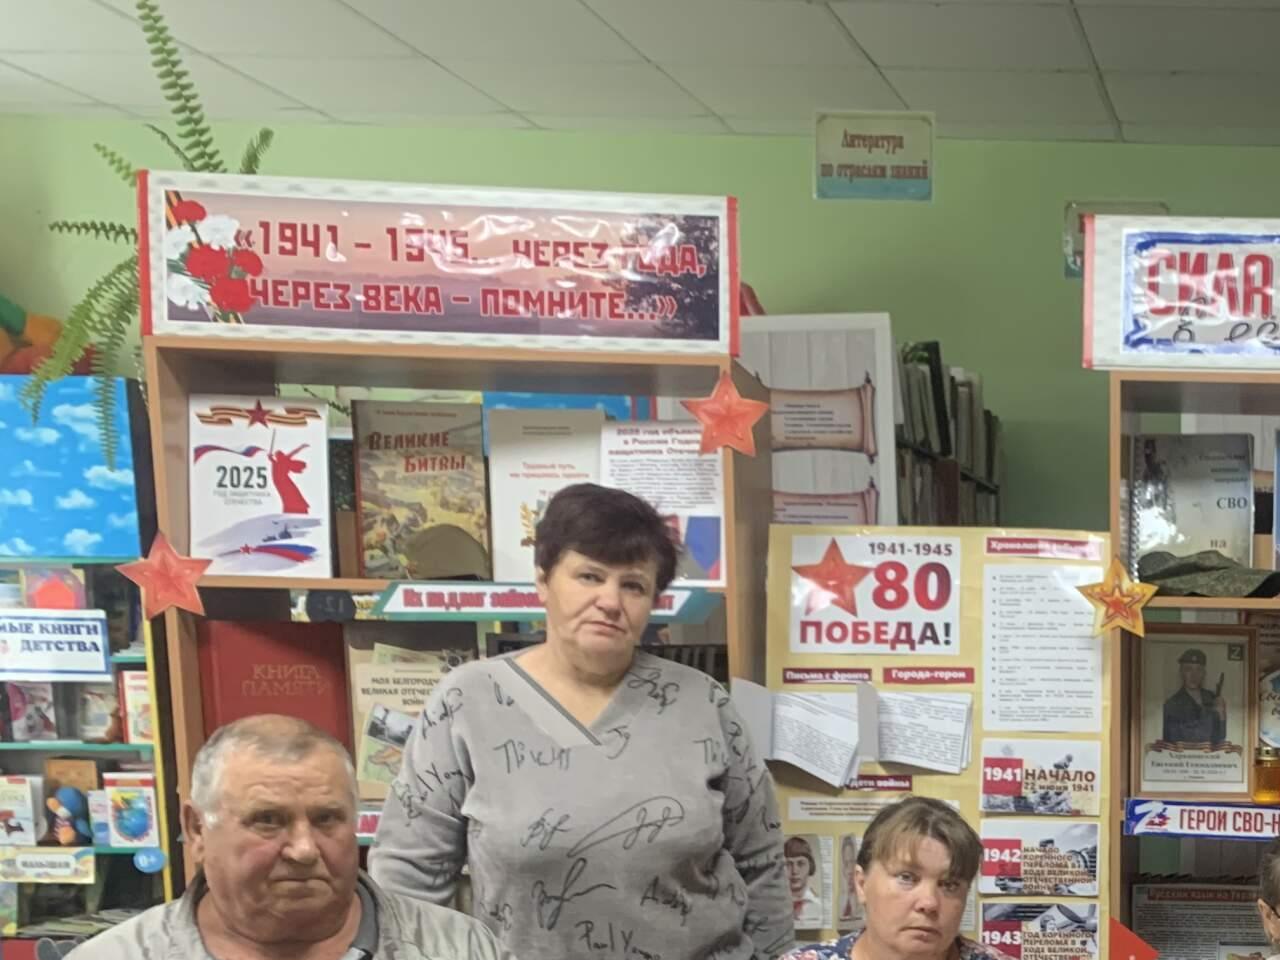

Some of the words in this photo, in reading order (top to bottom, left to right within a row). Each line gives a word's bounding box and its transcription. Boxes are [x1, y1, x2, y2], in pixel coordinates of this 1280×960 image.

[841, 128, 904, 154] Литература
[512, 239, 609, 269] ЧЕРЕЗ
[249, 278, 351, 311] ЧЕРЕЗ
[361, 283, 444, 317] ВЕКА
[215, 465, 268, 489] 2025
[1216, 496, 1248, 509] СВО
[868, 542, 954, 558] 1941-1945
[871, 560, 953, 611] 80
[39, 623, 99, 636] КНИГИ
[799, 619, 952, 651] ПОБЕДА!
[20, 639, 101, 653] ДЕТСТВА
[252, 664, 321, 681] КНИГА
[785, 670, 824, 680] Письма
[891, 669, 967, 682] Города-герои
[240, 680, 333, 698] ПАМЯТИ
[392, 677, 439, 686] БЕЛГОРОДЧ
[361, 687, 399, 696] ВЕЛИКАЯ
[401, 687, 434, 696] ОТЕЧЕС
[983, 766, 1023, 782] 1941
[1024, 768, 1096, 783] НАЧАЛО
[1071, 784, 1095, 792] 1941
[1179, 808, 1228, 830] ГЕРОИ
[982, 848, 1022, 862] 1942
[982, 930, 1022, 945] 1943
